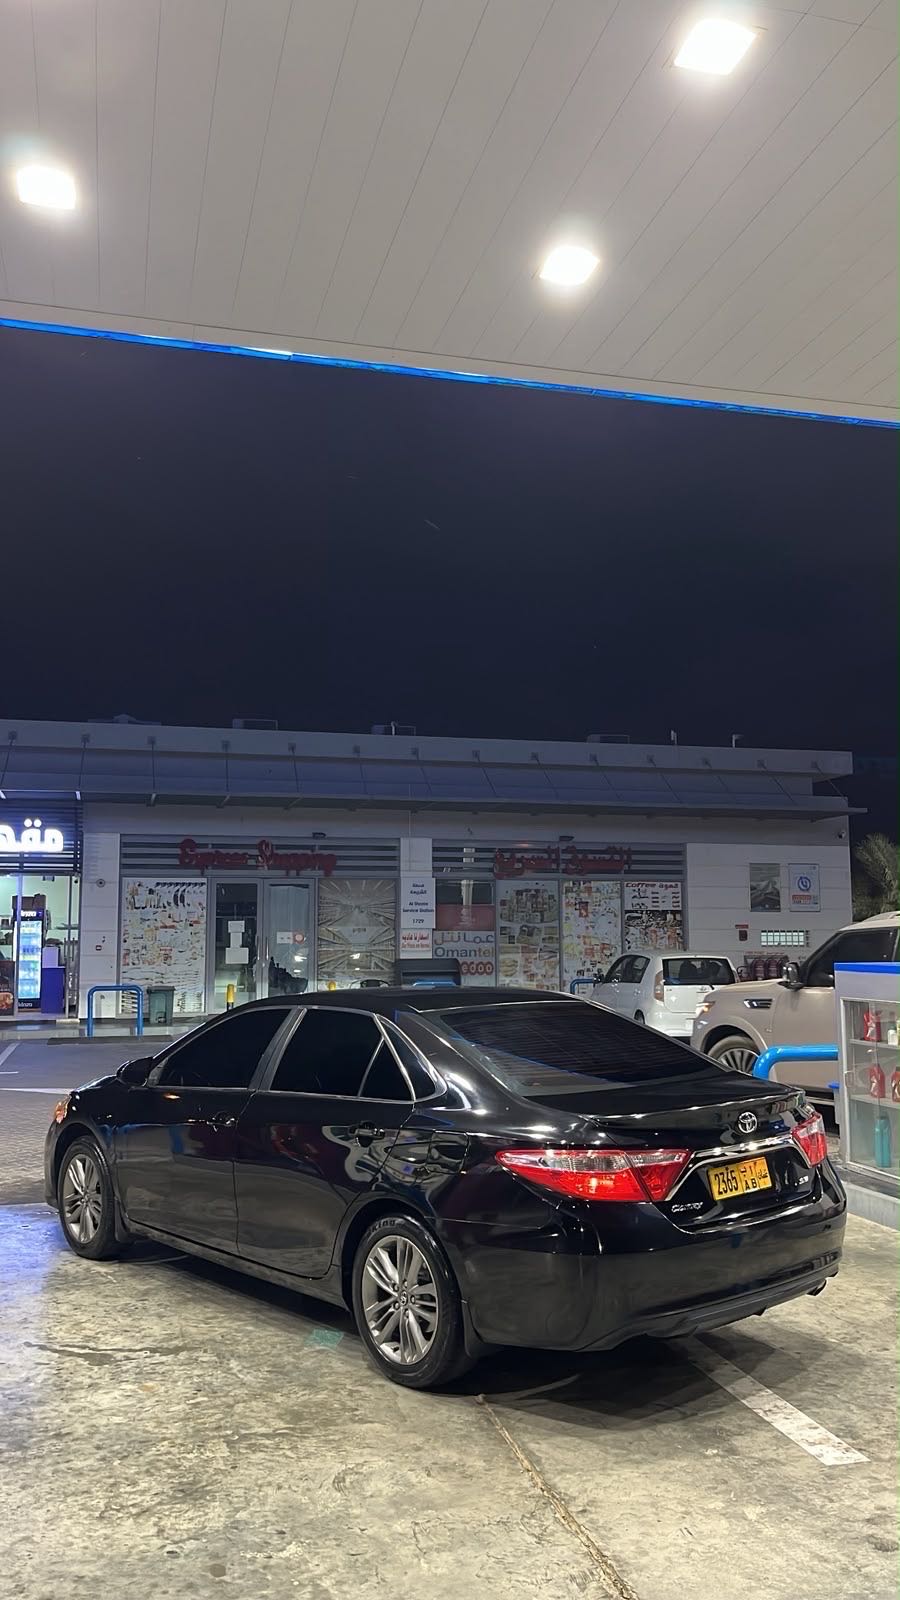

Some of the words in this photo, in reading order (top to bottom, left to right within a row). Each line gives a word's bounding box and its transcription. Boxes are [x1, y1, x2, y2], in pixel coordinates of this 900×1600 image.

[434, 931, 494, 945] عمانتل
[434, 946, 494, 958] Omantel
[714, 1168, 739, 1196] 2365
